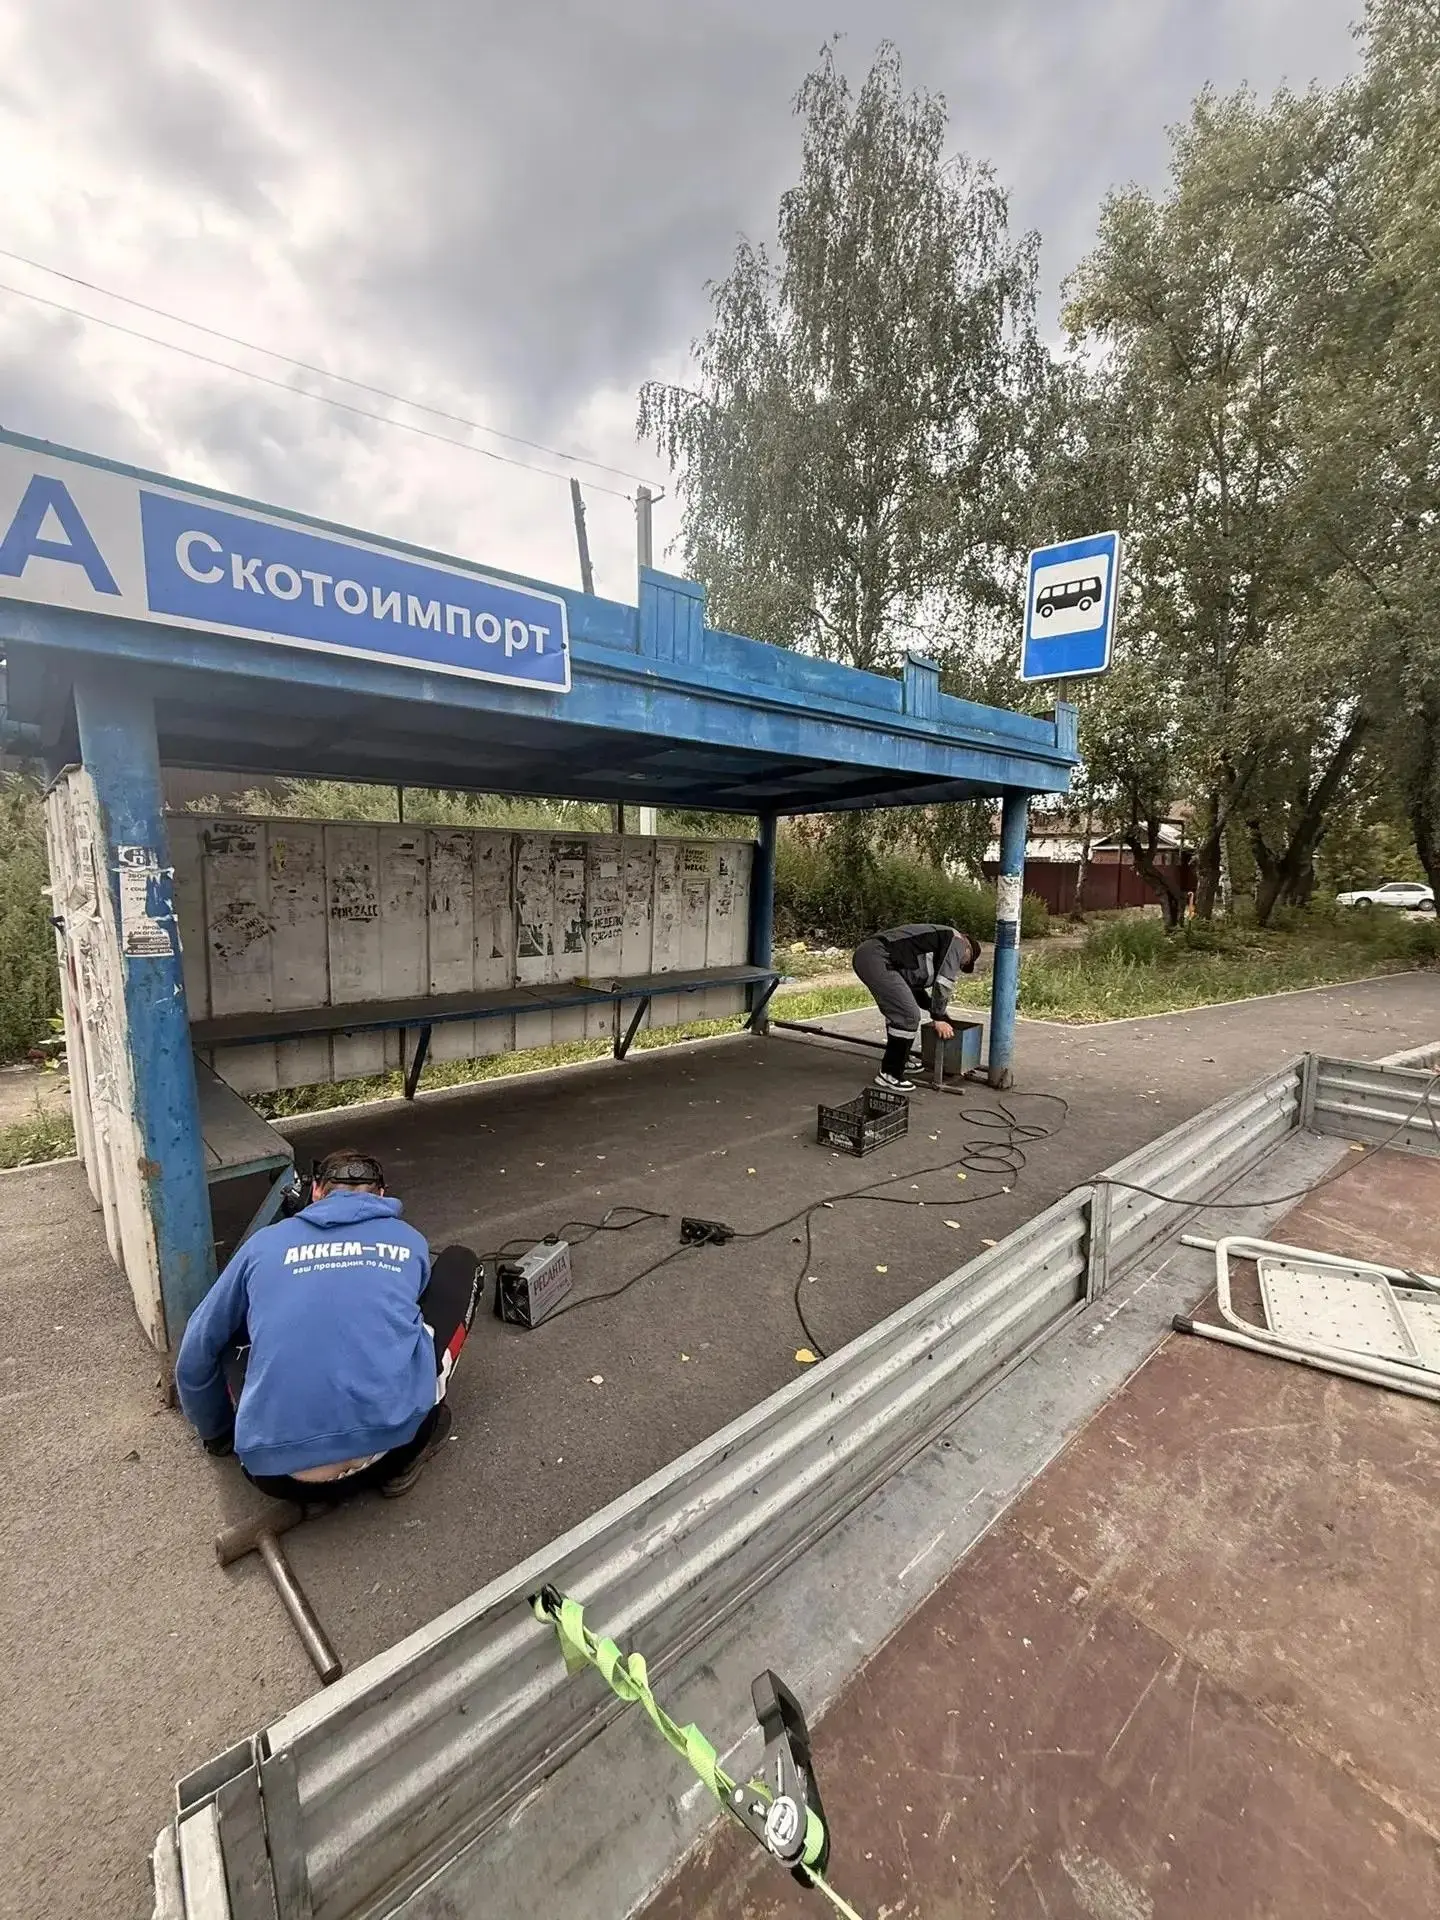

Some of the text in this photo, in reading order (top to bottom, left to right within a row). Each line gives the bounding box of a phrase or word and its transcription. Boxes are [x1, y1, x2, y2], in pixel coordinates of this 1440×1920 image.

[0, 474, 550, 657] А Скотоимпорт
[293, 1266, 311, 1275] ваш
[313, 1260, 364, 1271] проводник
[378, 1261, 402, 1273] Алтаю
[533, 1256, 567, 1297] РЕСАНТА
